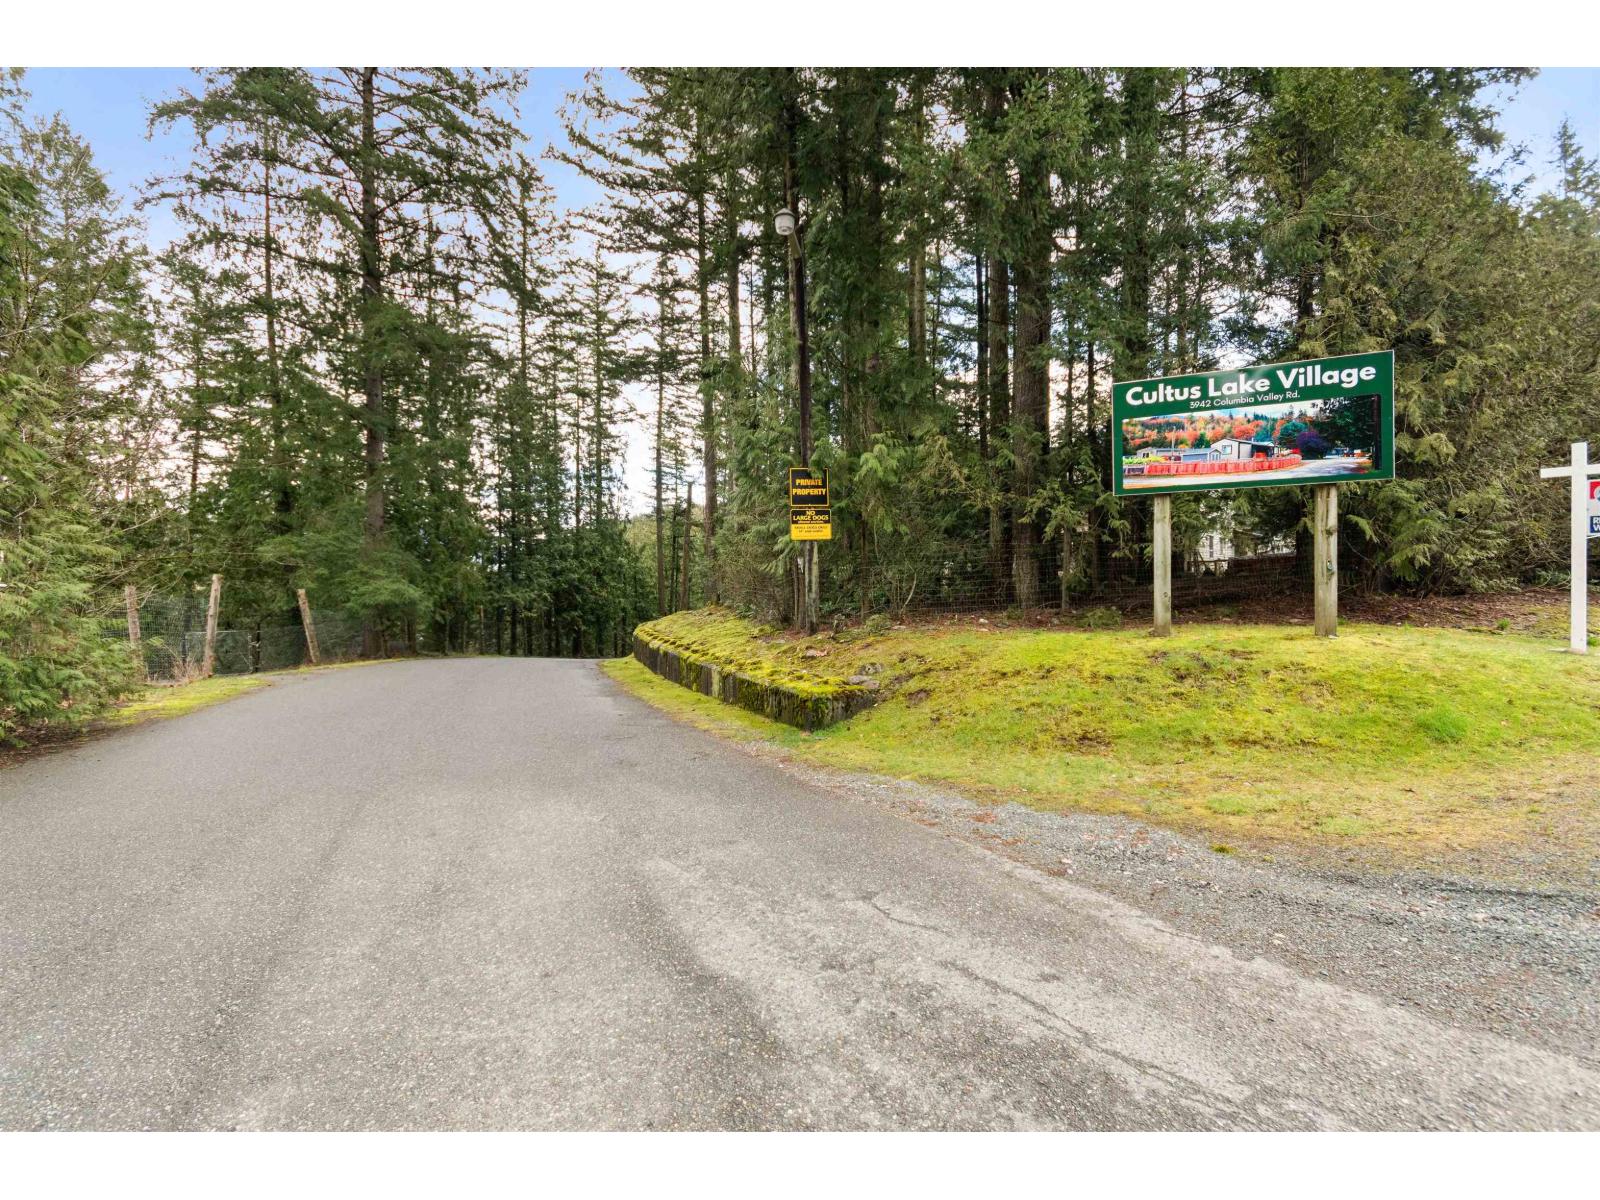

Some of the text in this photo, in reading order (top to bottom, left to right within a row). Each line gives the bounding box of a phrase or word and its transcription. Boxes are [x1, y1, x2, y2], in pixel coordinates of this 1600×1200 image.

[1126, 364, 1377, 406] Cultus Lake Village
[1213, 397, 1254, 406] Columbia
[1256, 393, 1284, 402] Valley
[1285, 390, 1301, 399] Rd.
